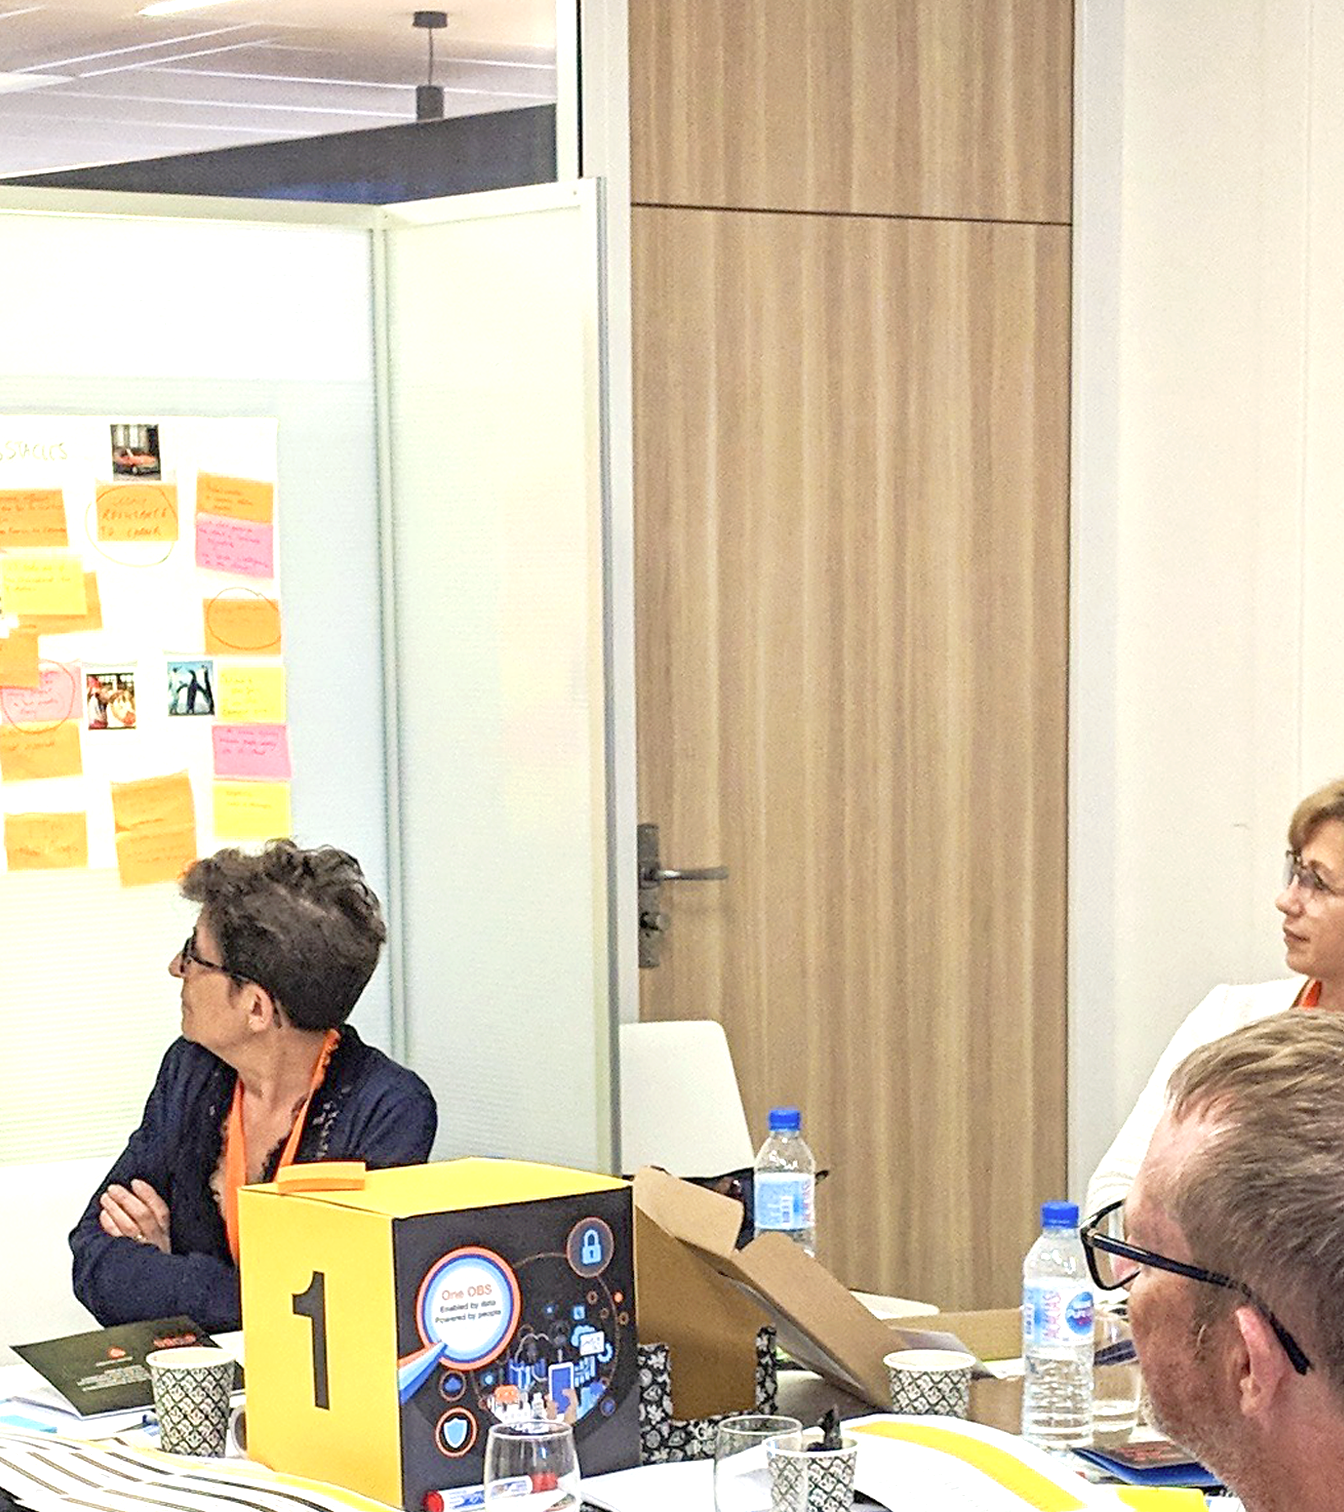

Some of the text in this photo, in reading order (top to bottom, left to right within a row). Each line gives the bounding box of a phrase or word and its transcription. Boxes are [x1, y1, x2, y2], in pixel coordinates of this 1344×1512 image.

[441, 1283, 493, 1301] One OBS
[440, 1299, 496, 1313] Enabled by data
[435, 1309, 503, 1324] Powered by people
[291, 1270, 331, 1411] 1
